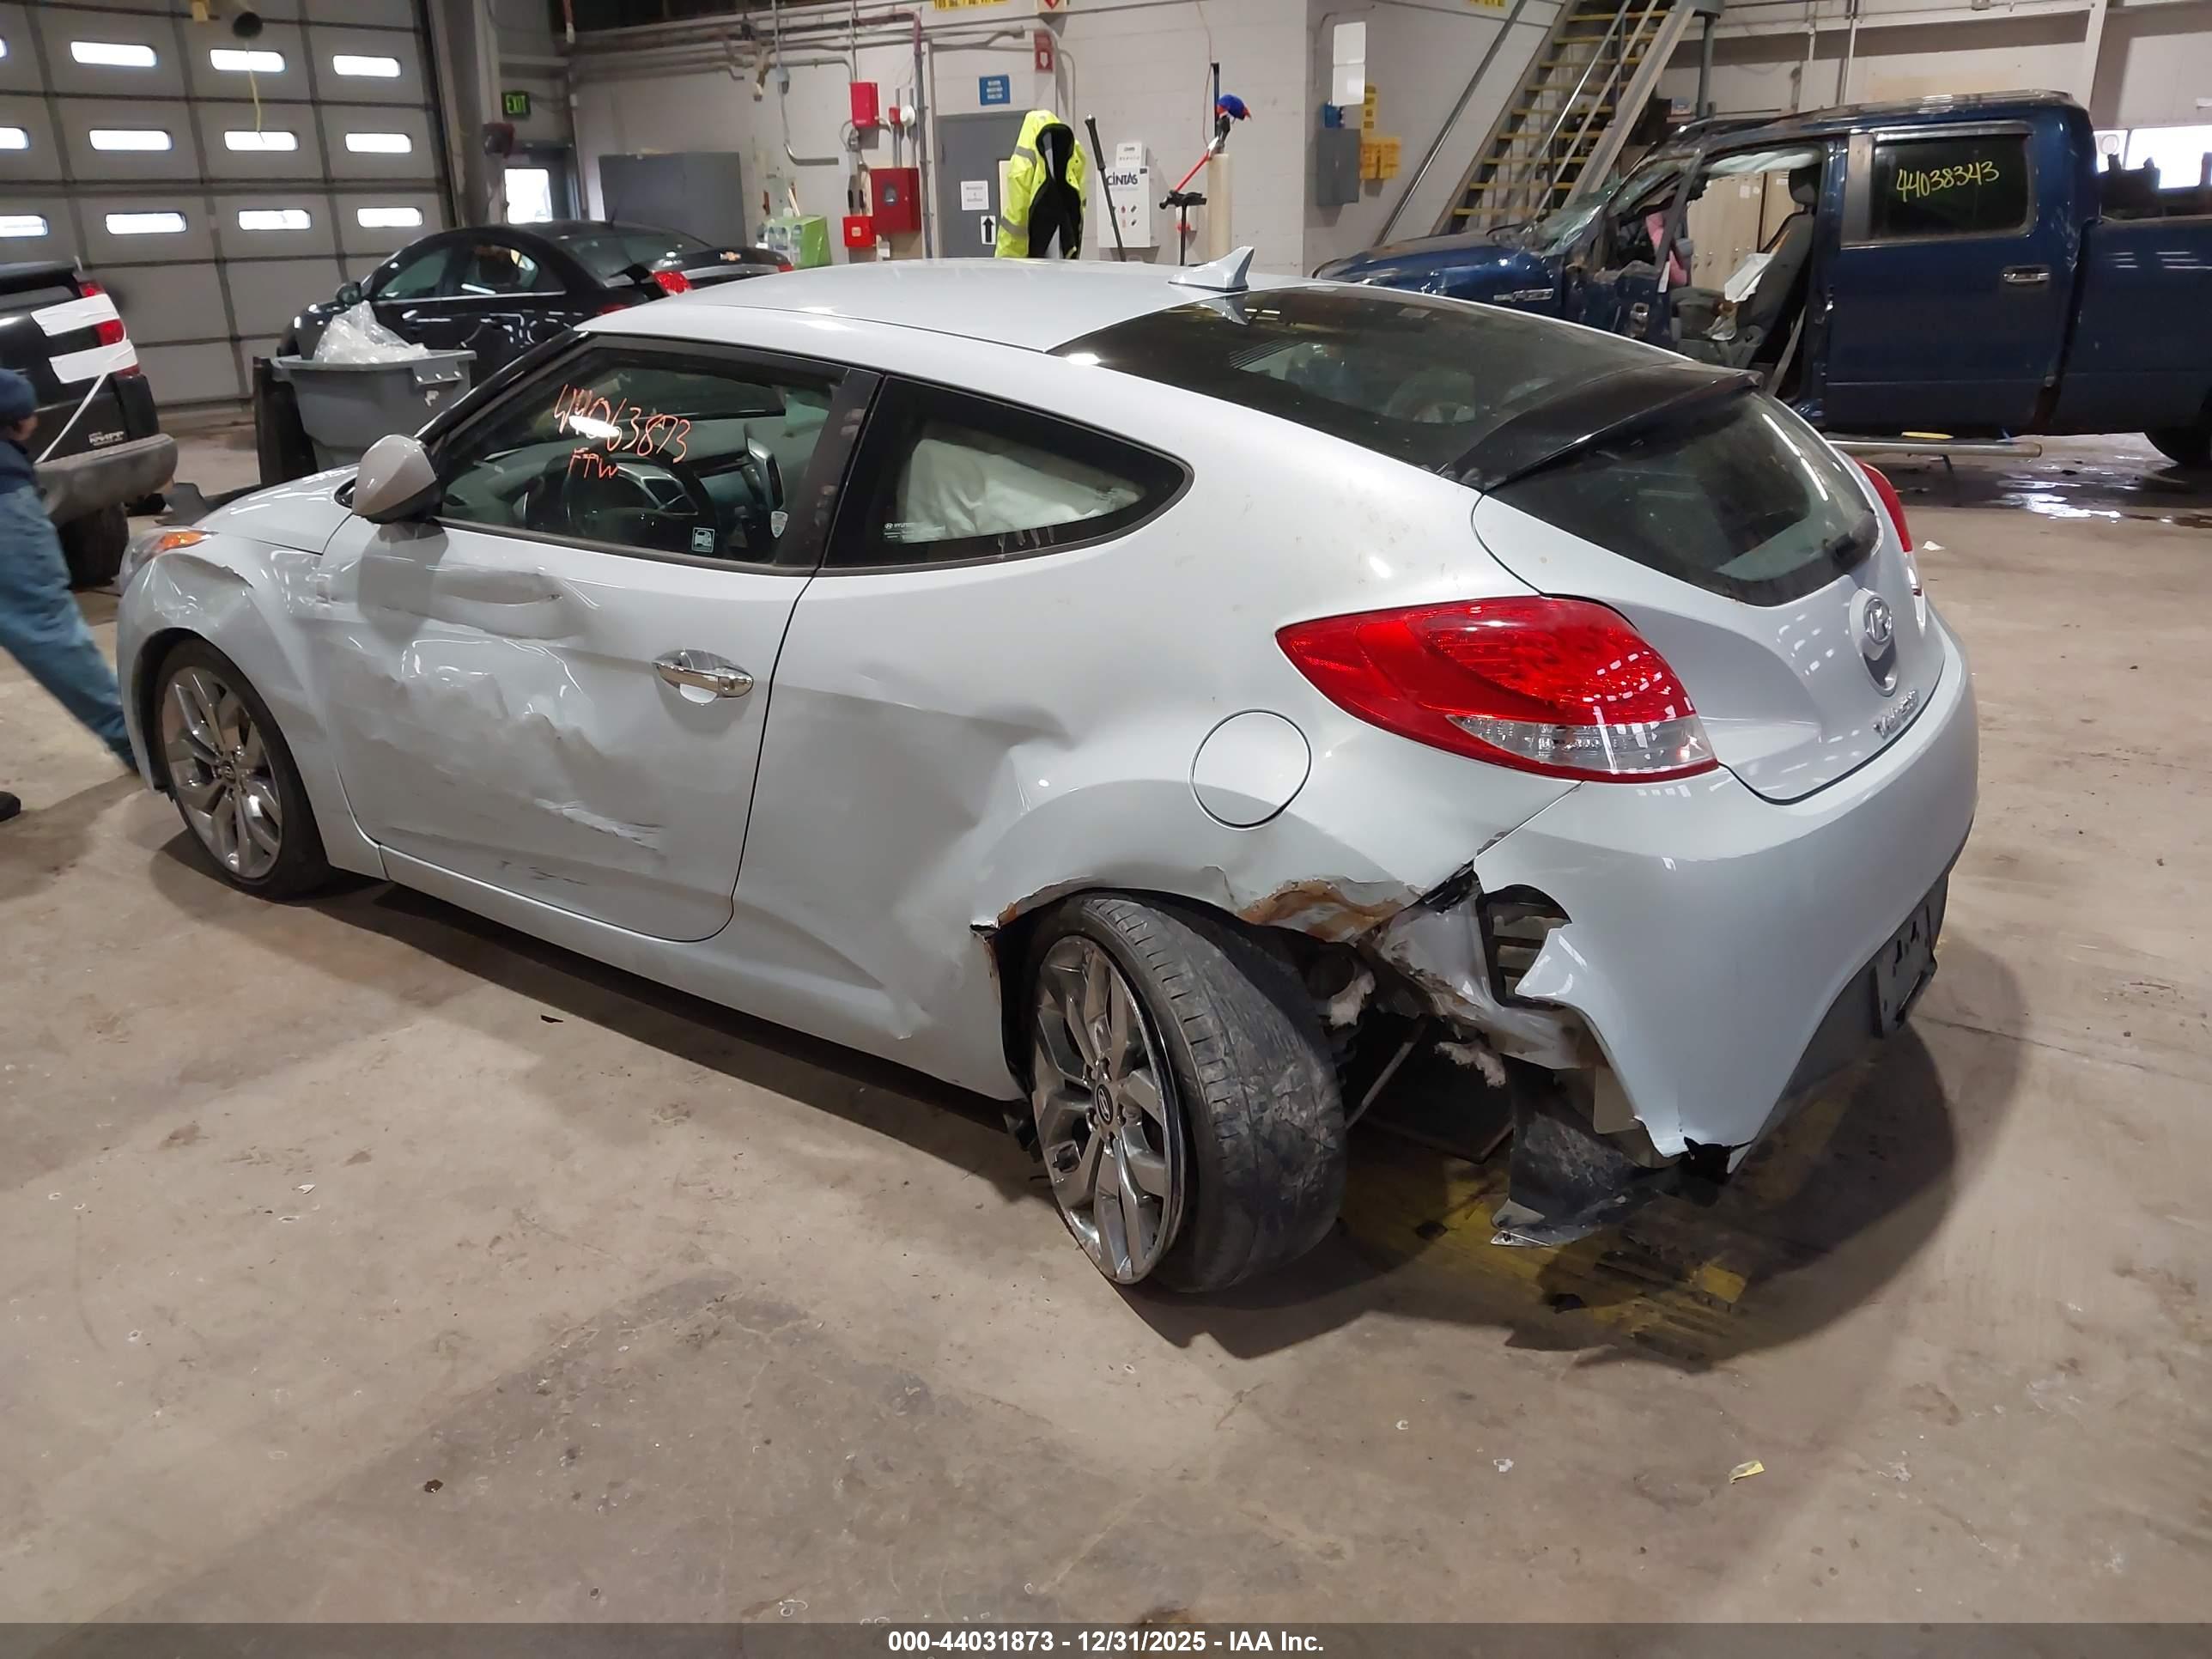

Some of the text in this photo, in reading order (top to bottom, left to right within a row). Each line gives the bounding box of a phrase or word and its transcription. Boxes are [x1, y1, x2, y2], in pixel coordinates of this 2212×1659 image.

[506, 94, 526, 114] EXIT
[1896, 161, 2000, 203] 44038343
[554, 384, 690, 464] 44063873
[568, 447, 619, 479] FTW
